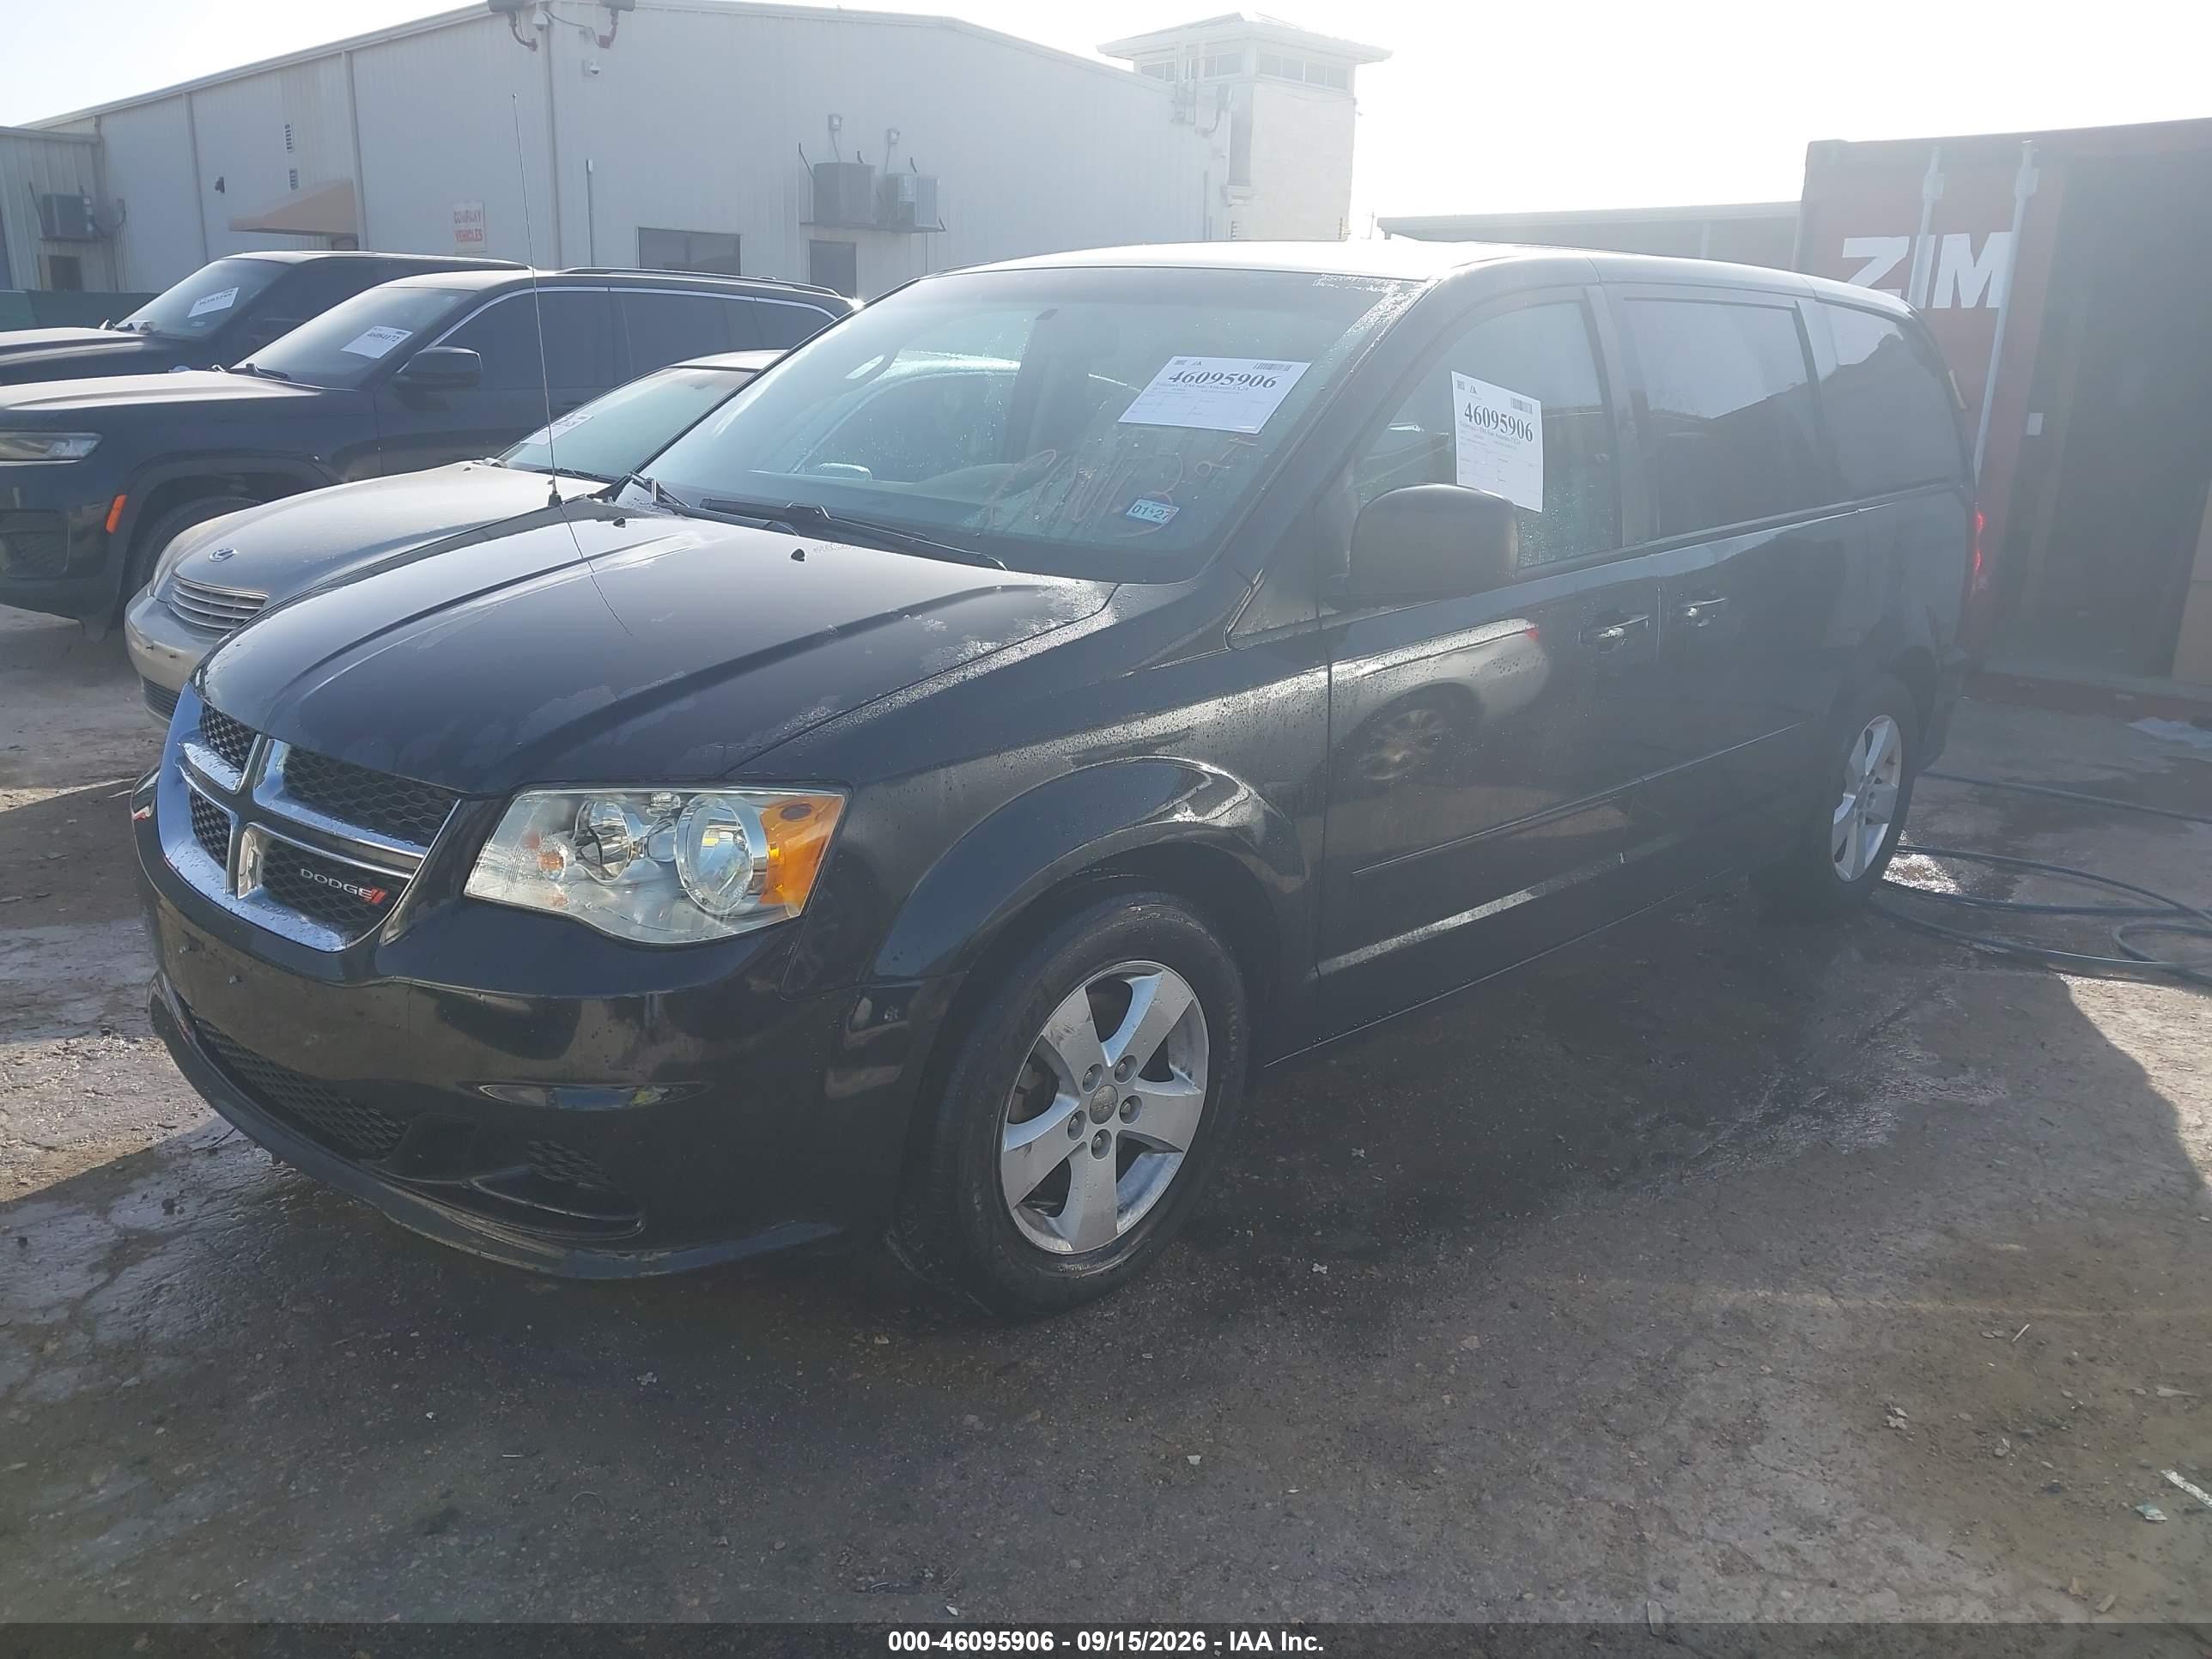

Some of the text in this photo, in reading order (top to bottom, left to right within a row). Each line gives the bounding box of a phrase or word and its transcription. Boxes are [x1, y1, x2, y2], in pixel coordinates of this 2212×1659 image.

[1842, 232, 2014, 310] ZIM
[1168, 370, 1281, 389] 46095906
[1464, 402, 1534, 442] 46095906
[301, 867, 373, 900] DODGE
